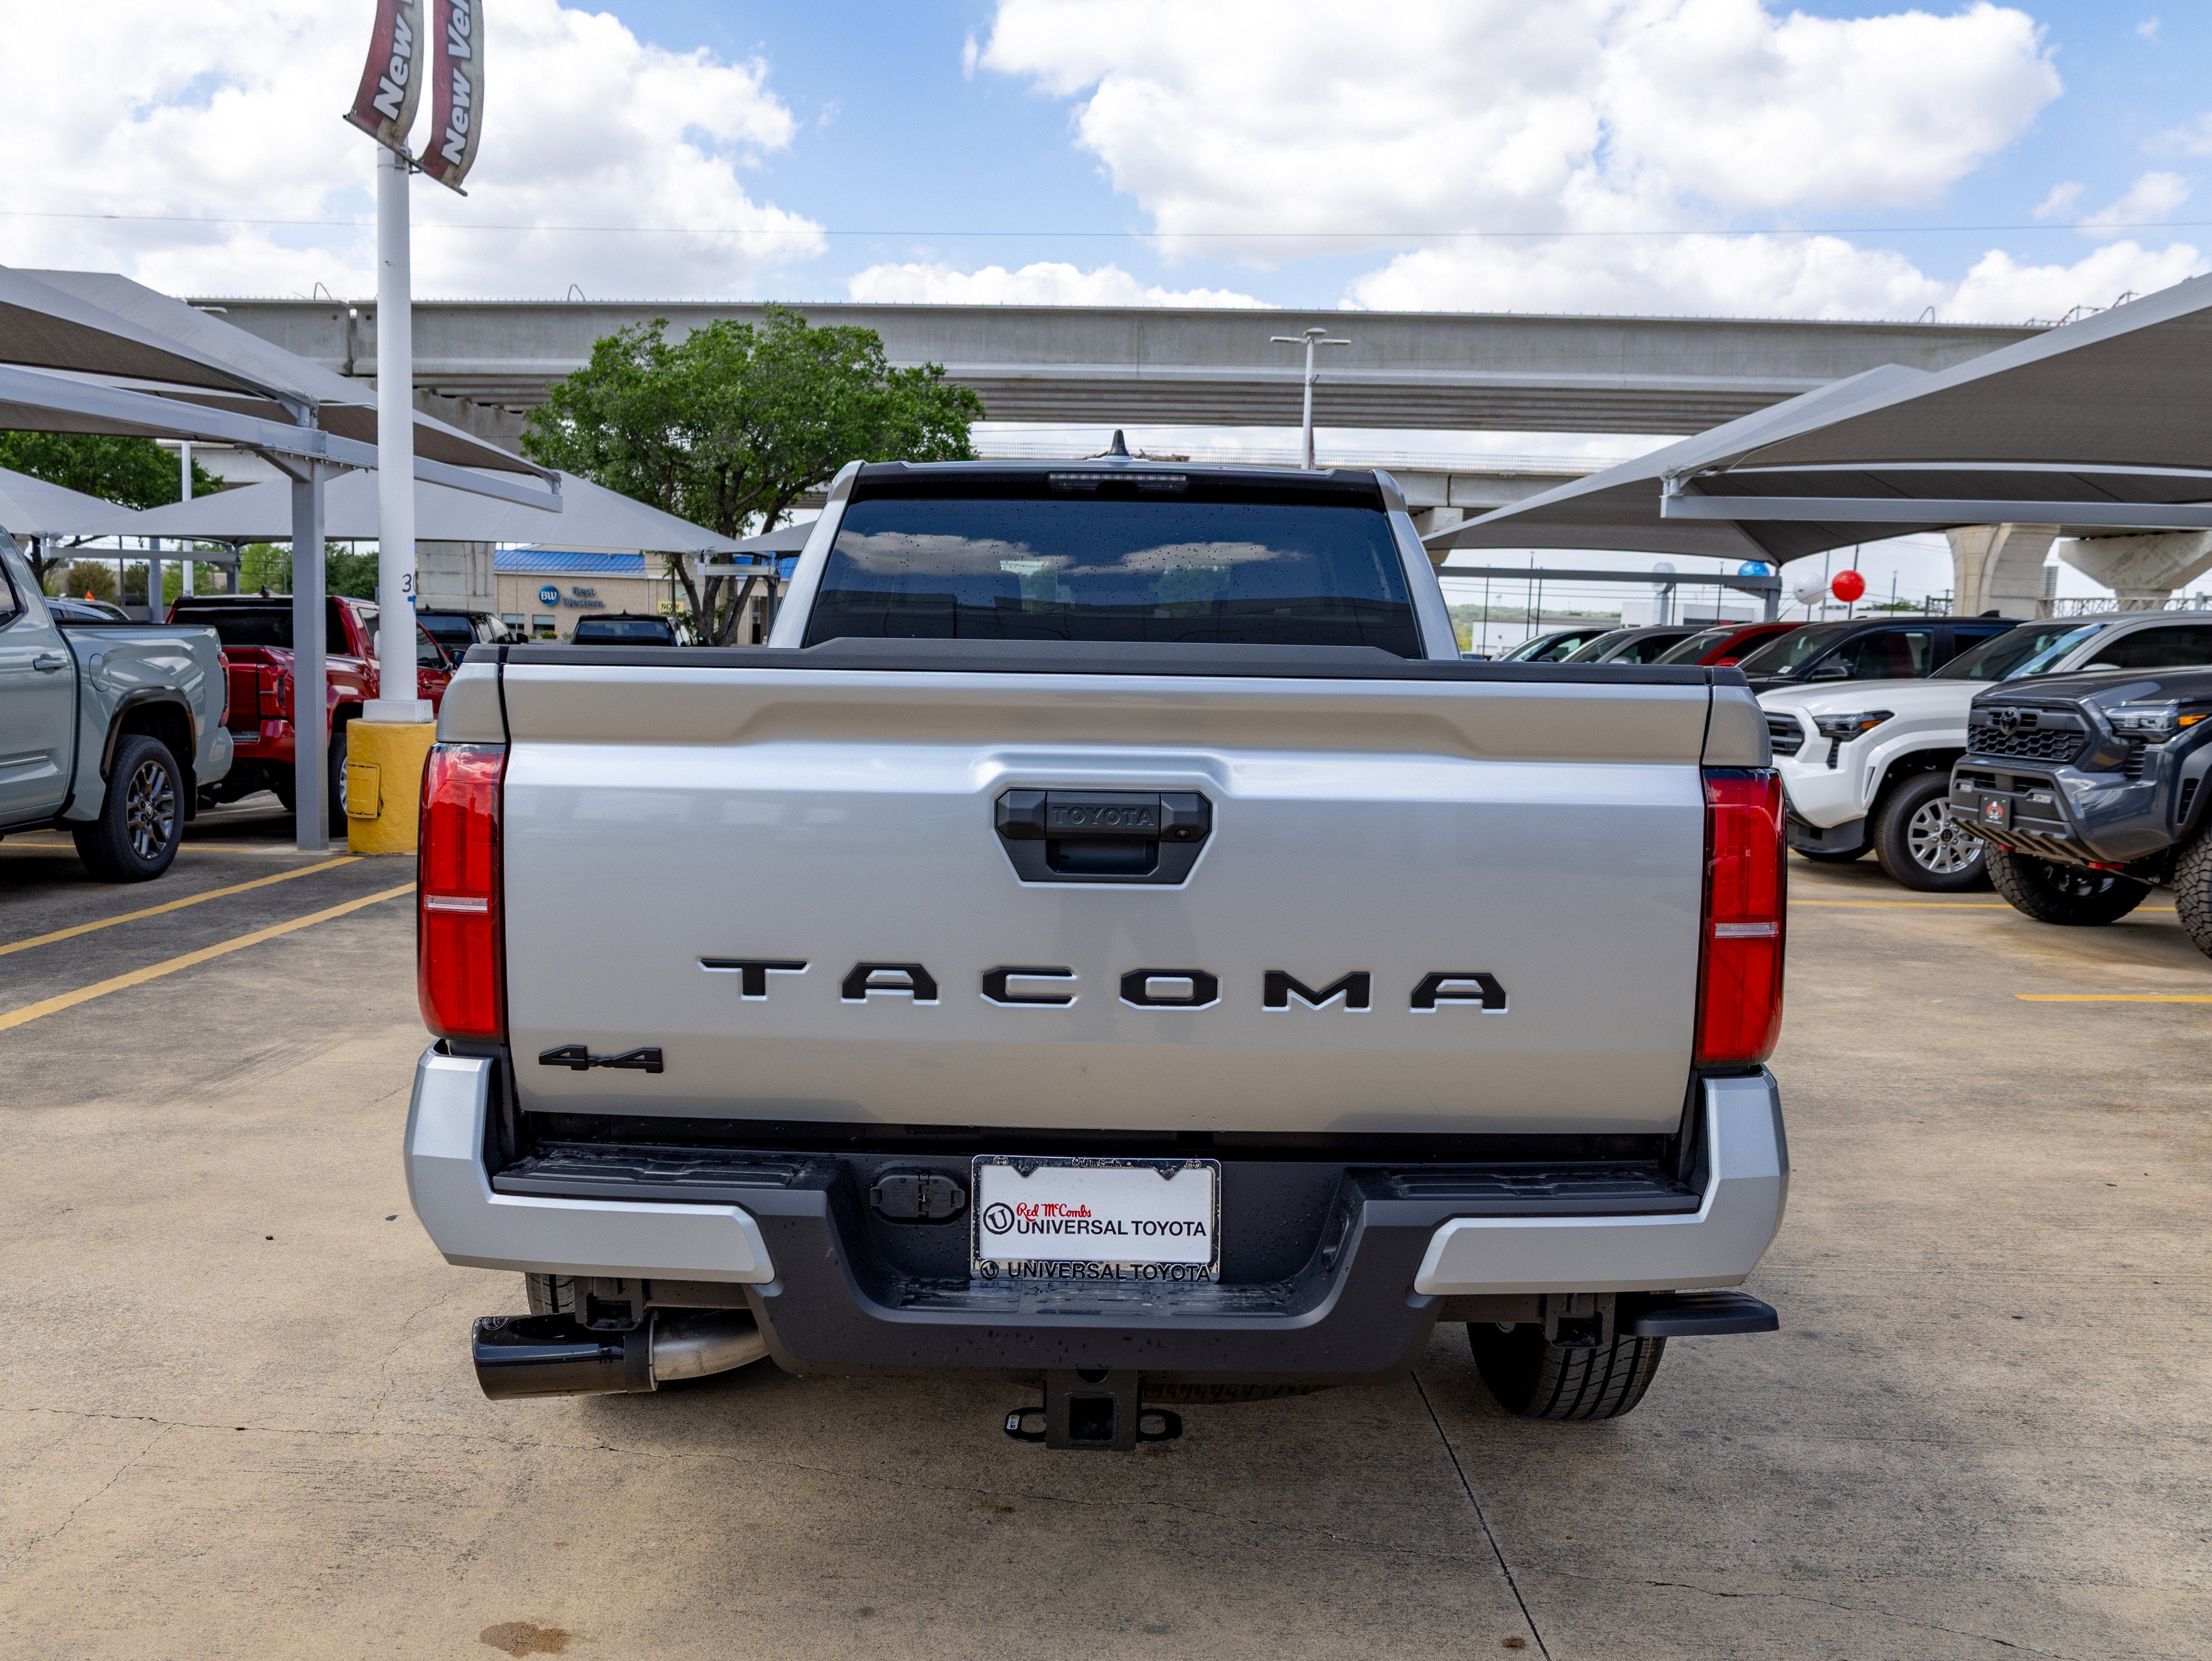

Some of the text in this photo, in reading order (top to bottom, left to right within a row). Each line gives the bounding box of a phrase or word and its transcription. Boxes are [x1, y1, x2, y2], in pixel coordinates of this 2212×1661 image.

[373, 13, 412, 120] New
[441, 67, 471, 166] New
[541, 591, 557, 600] BW
[571, 587, 595, 596] Best
[562, 596, 604, 607] Western
[1052, 807, 1154, 826] TOYOTA
[699, 959, 1508, 1012] TACOMA
[1072, 1157, 1122, 1168] Red McCombs
[1016, 1202, 1092, 1222] Red McCombs
[1017, 1220, 1207, 1236] UNIVERSAL TOYOTA
[1007, 1261, 1127, 1280] UNIVERSAL
[1127, 1263, 1211, 1282] TOYOTA
